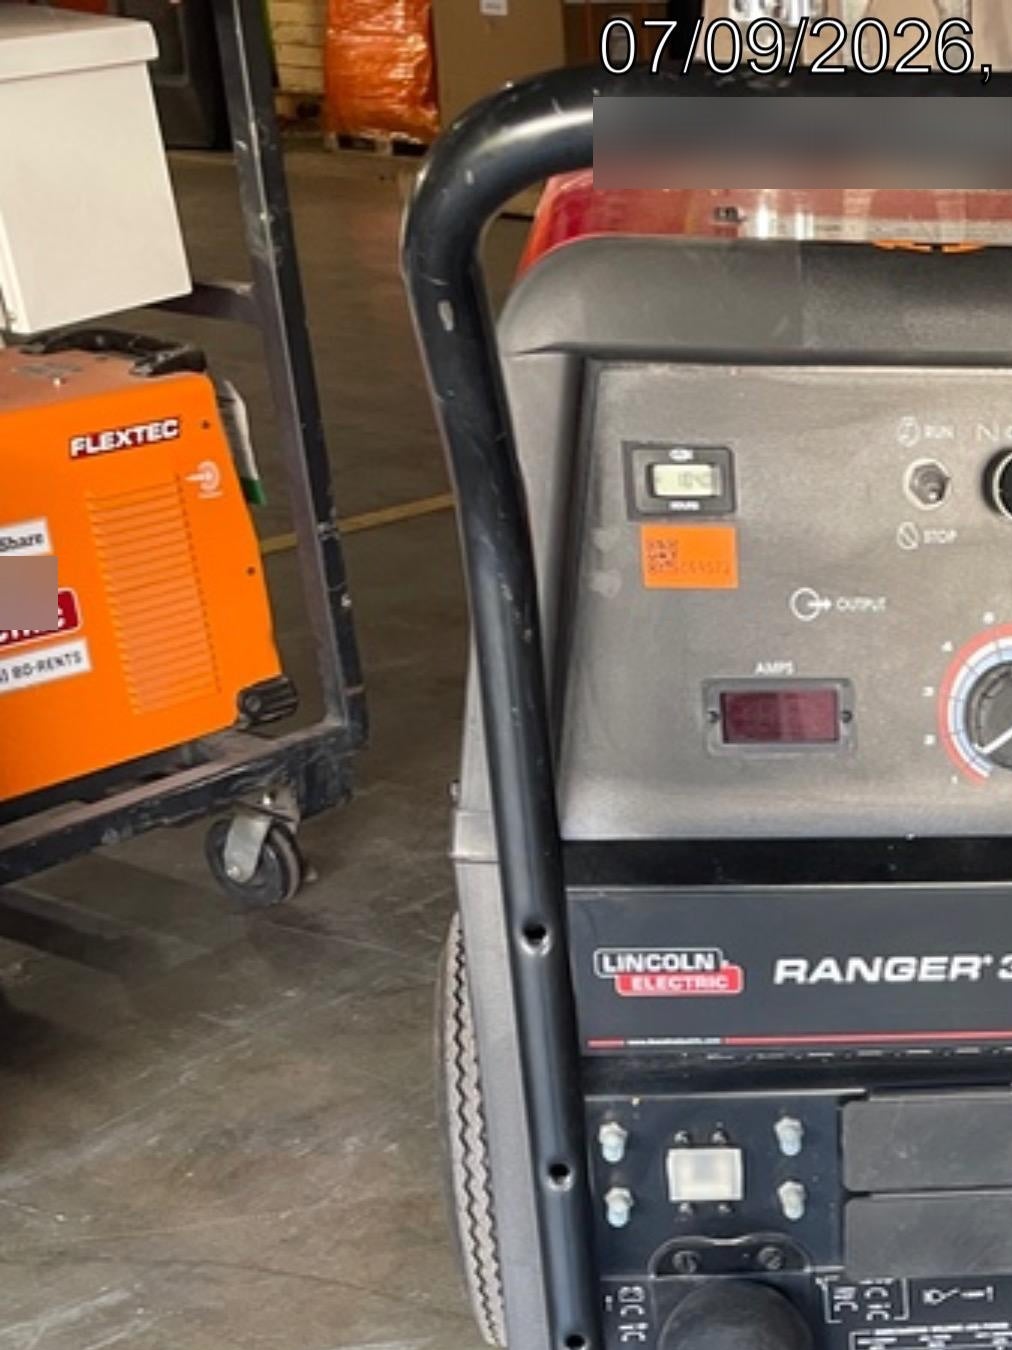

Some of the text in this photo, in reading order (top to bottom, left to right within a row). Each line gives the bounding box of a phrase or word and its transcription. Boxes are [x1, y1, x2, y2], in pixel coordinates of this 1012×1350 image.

[70, 420, 179, 457] FLEXTEC
[754, 661, 795, 675] AMPS
[602, 953, 716, 974] LINCOLN
[629, 973, 730, 992] ELECTRIC
